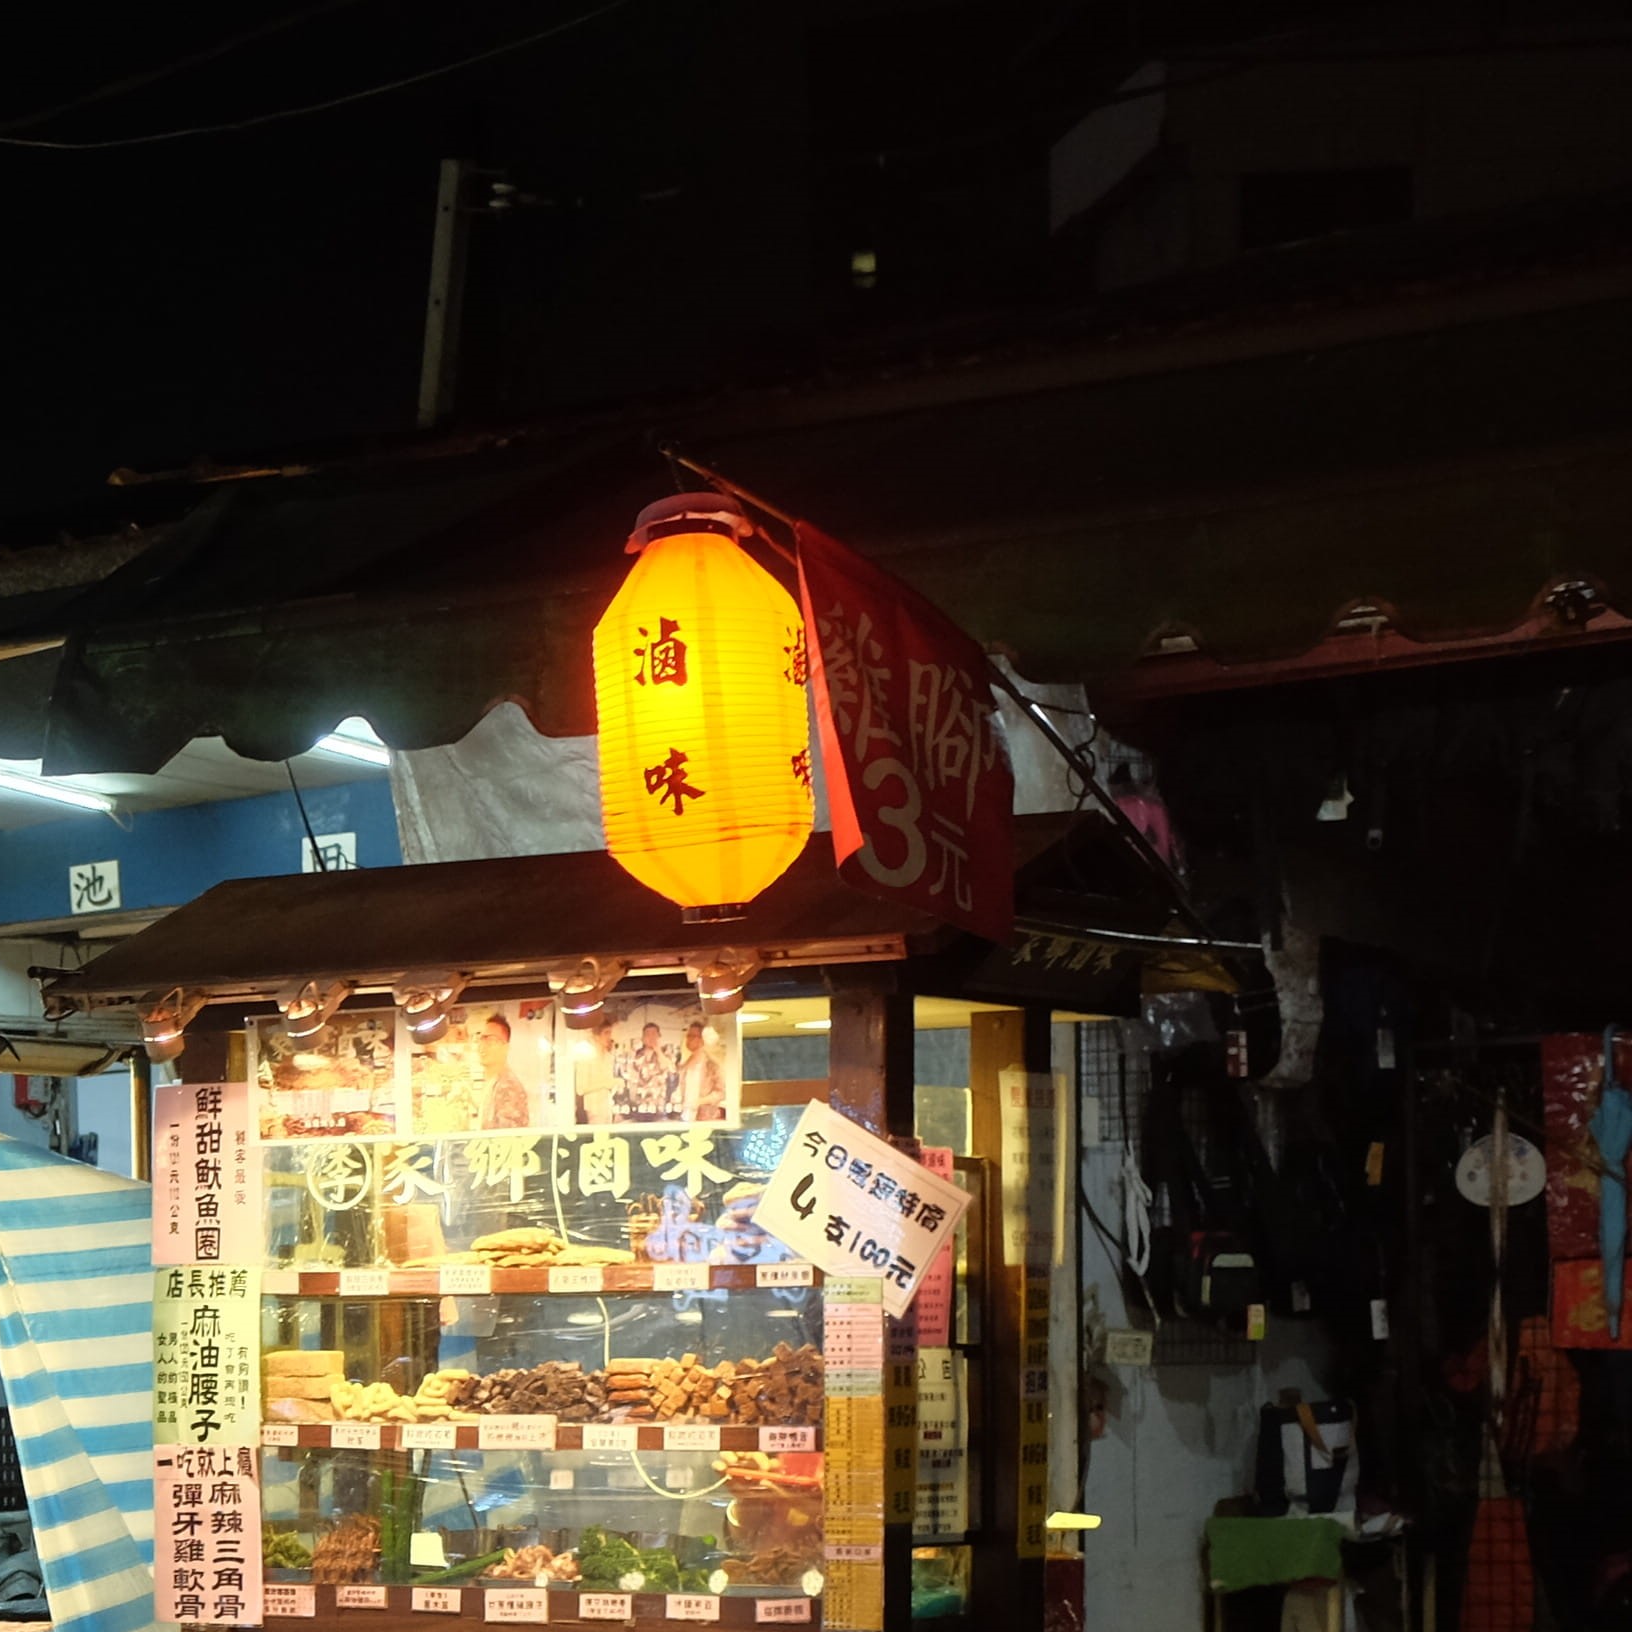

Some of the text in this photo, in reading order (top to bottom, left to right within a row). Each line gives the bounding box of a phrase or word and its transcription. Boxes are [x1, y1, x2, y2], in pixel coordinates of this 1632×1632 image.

[634, 617, 706, 816] 滷味
[817, 602, 997, 822] 雞腳
[73, 865, 113, 908] 池
[857, 757, 973, 912] 3元
[195, 1087, 223, 1261] 鮮甜魷魚圈
[306, 1129, 736, 1211] 李家鄉滷味
[166, 1269, 248, 1299] 店長推薦
[189, 1305, 222, 1442] 麻油腰子
[157, 1446, 254, 1479] 一吃就上癮
[172, 1483, 205, 1620] 彈牙雞軟骨
[208, 1481, 245, 1620] 麻辣三角骨
